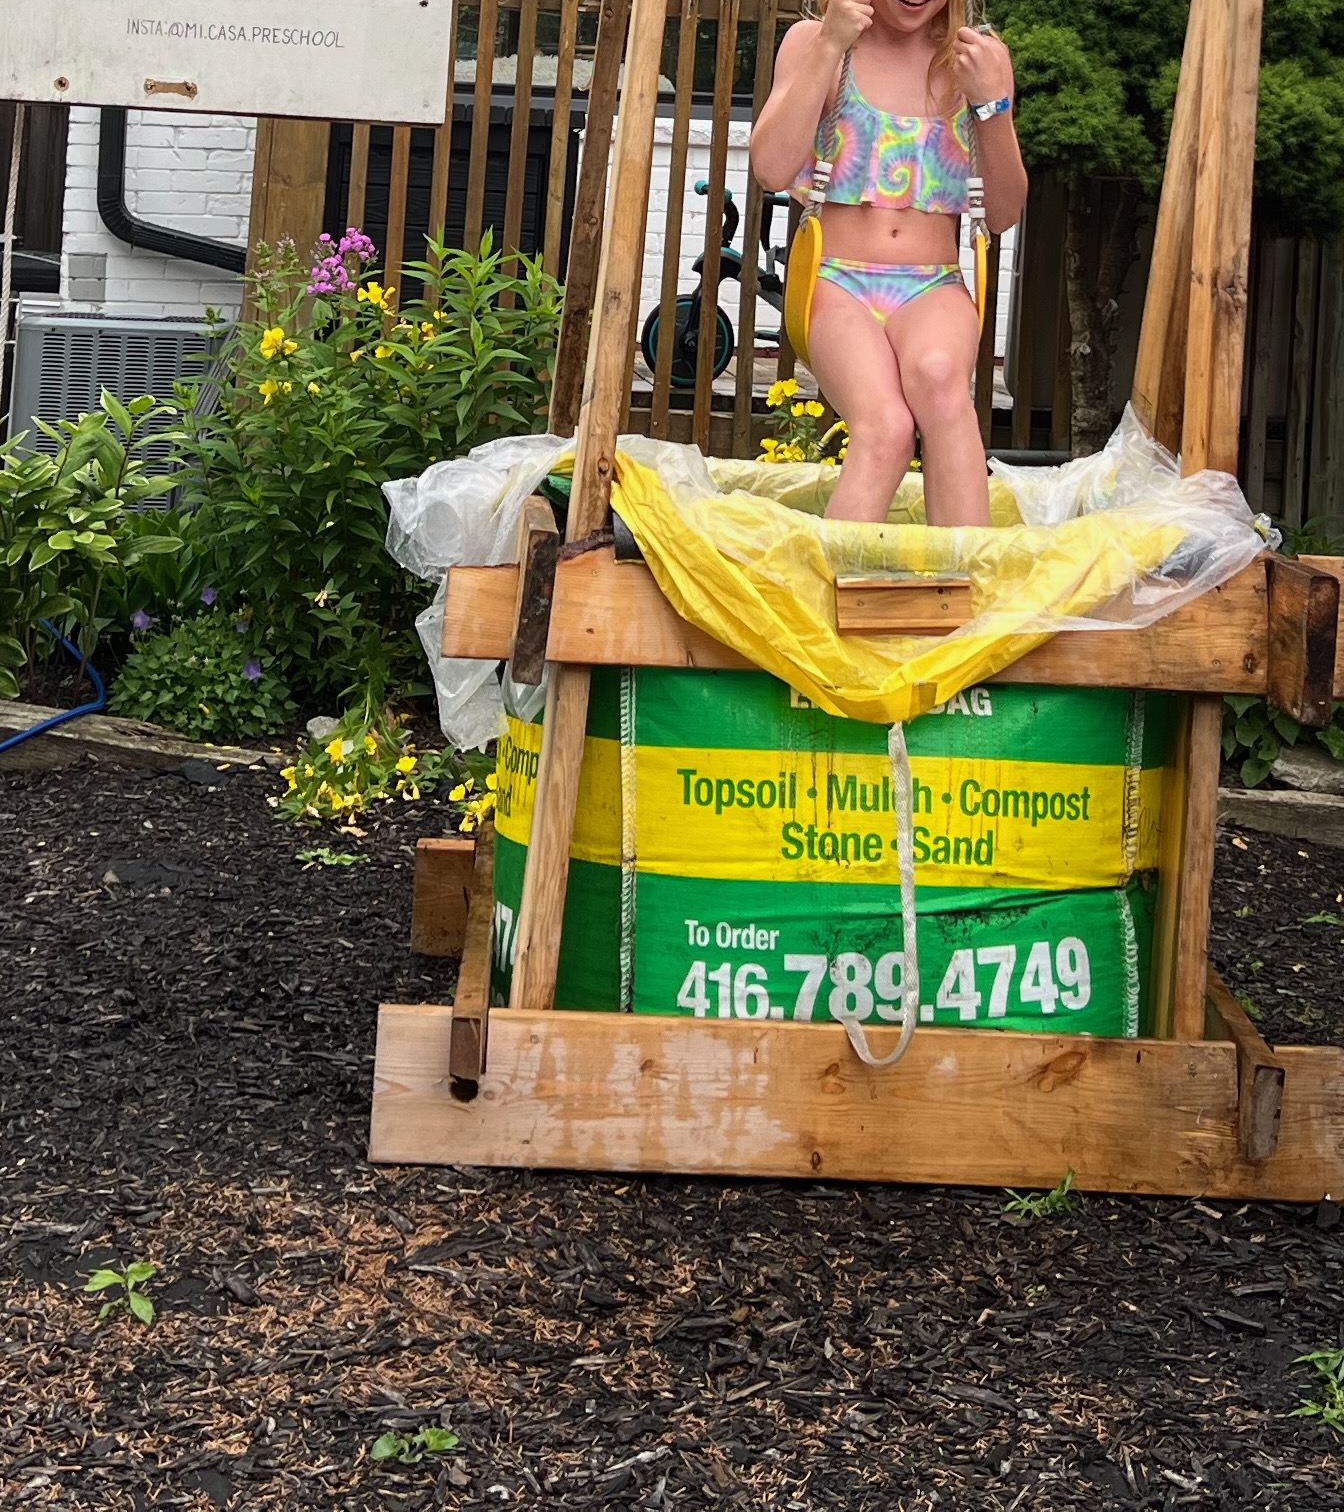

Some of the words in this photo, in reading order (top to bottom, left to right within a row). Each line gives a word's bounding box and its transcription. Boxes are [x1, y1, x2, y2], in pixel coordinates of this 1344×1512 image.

[676, 768, 797, 816] Topsoil
[827, 774, 933, 814] Mulh
[959, 778, 1092, 827] Compost
[780, 821, 883, 862] Stone
[912, 825, 995, 867] Sand
[684, 919, 710, 947] To
[715, 920, 780, 951] Order
